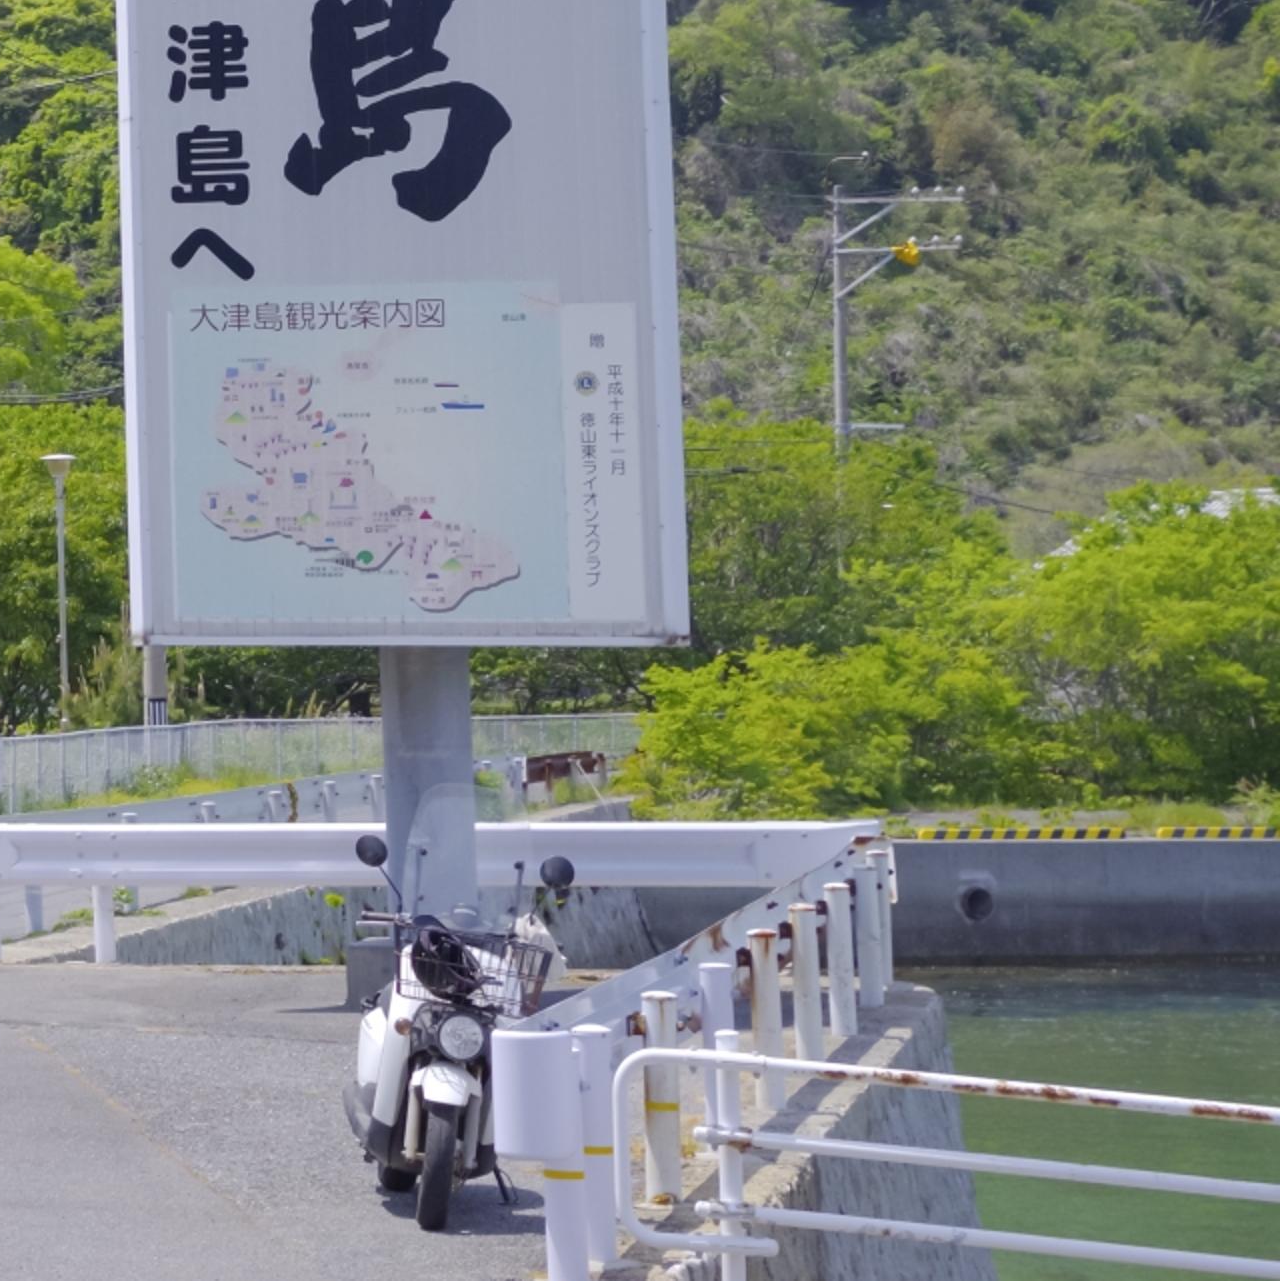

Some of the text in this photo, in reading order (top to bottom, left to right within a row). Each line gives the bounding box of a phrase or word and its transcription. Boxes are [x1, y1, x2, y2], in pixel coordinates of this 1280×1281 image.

[189, 298, 446, 333] 大津島観光案内図
[607, 364, 626, 476] 平成十年十一月
